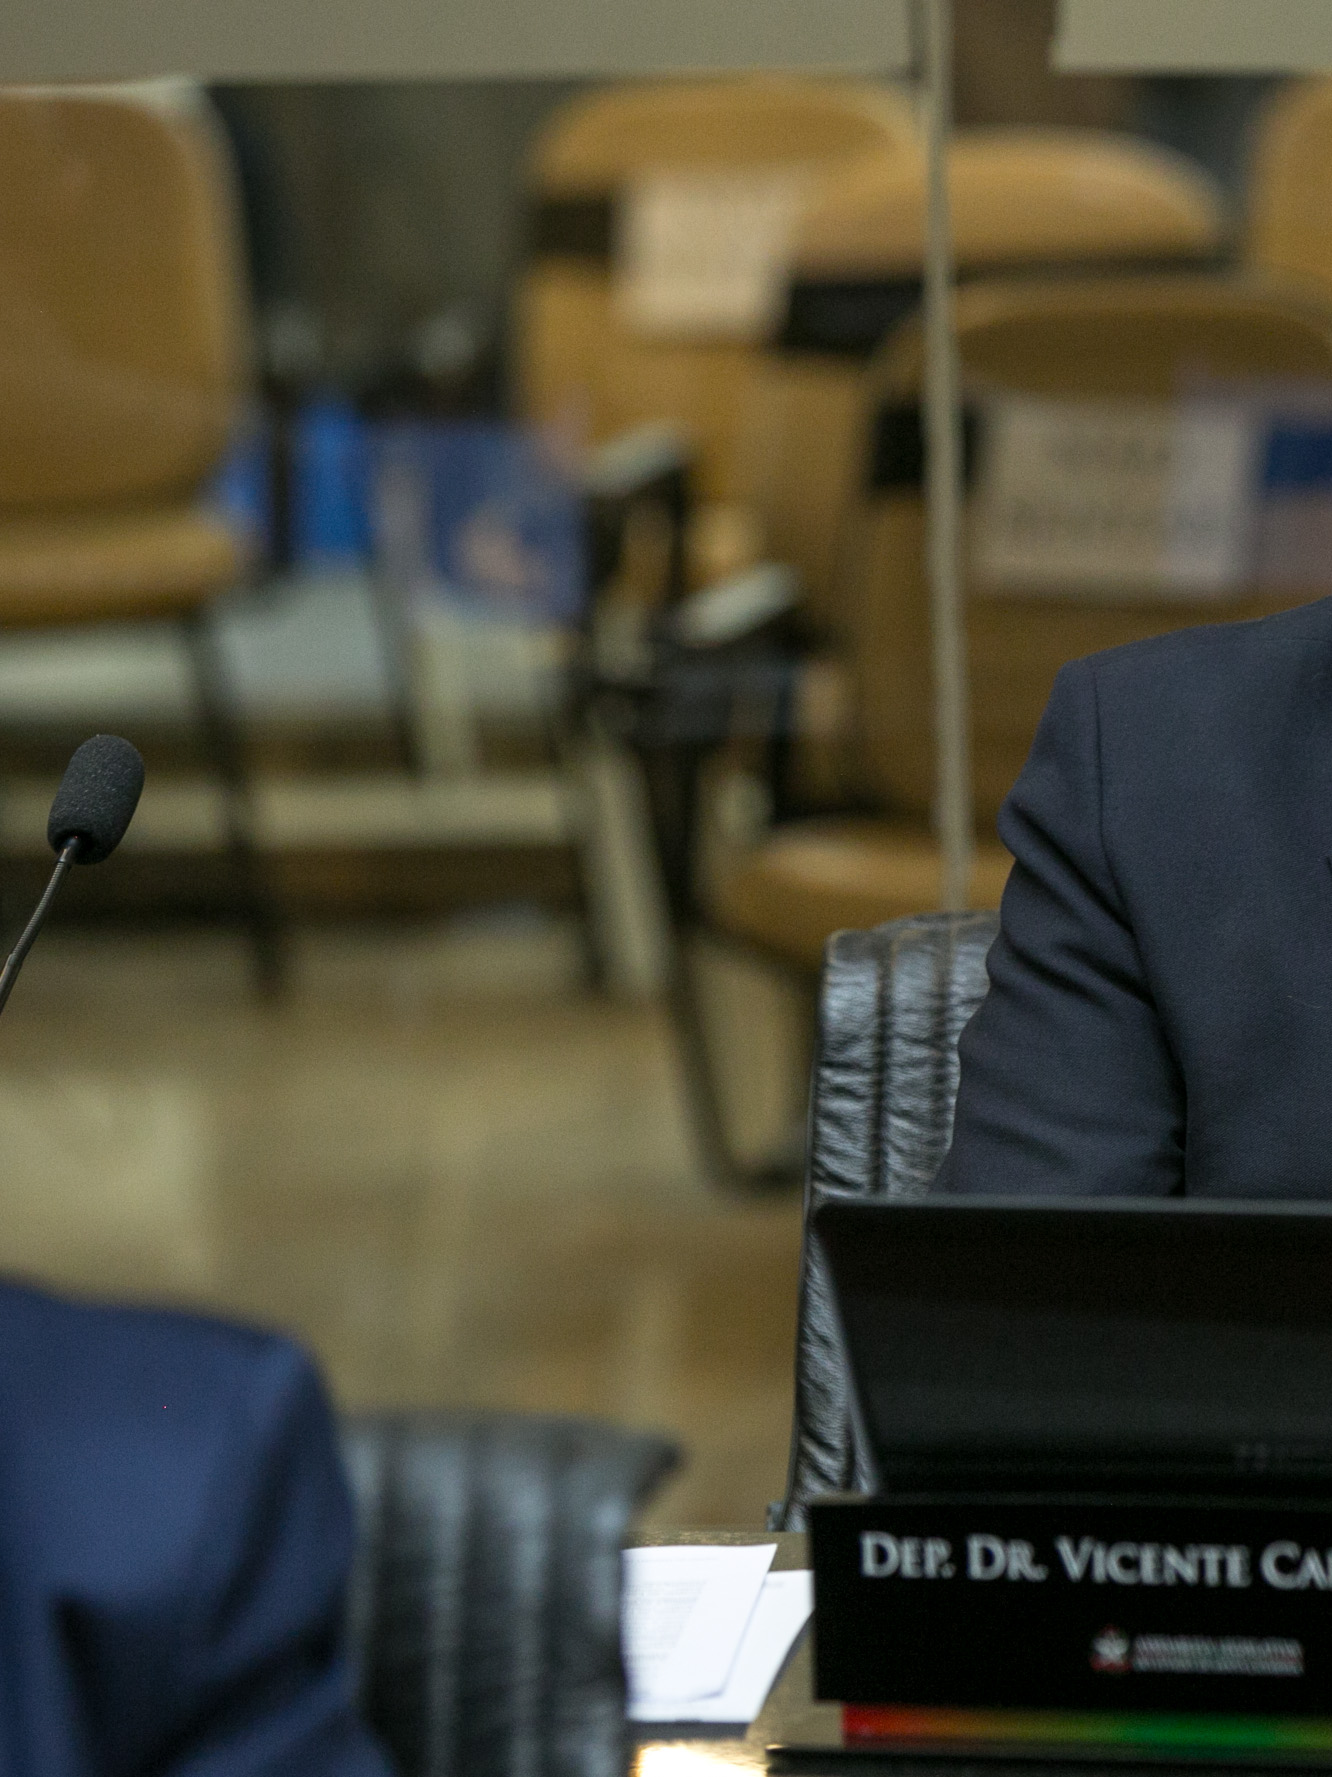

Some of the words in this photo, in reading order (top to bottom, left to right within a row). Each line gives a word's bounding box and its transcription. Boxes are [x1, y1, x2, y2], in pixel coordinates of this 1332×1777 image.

[860, 1530, 955, 1579] DEP.
[966, 1533, 1047, 1582] DR.
[1054, 1535, 1250, 1588] VICENTE
